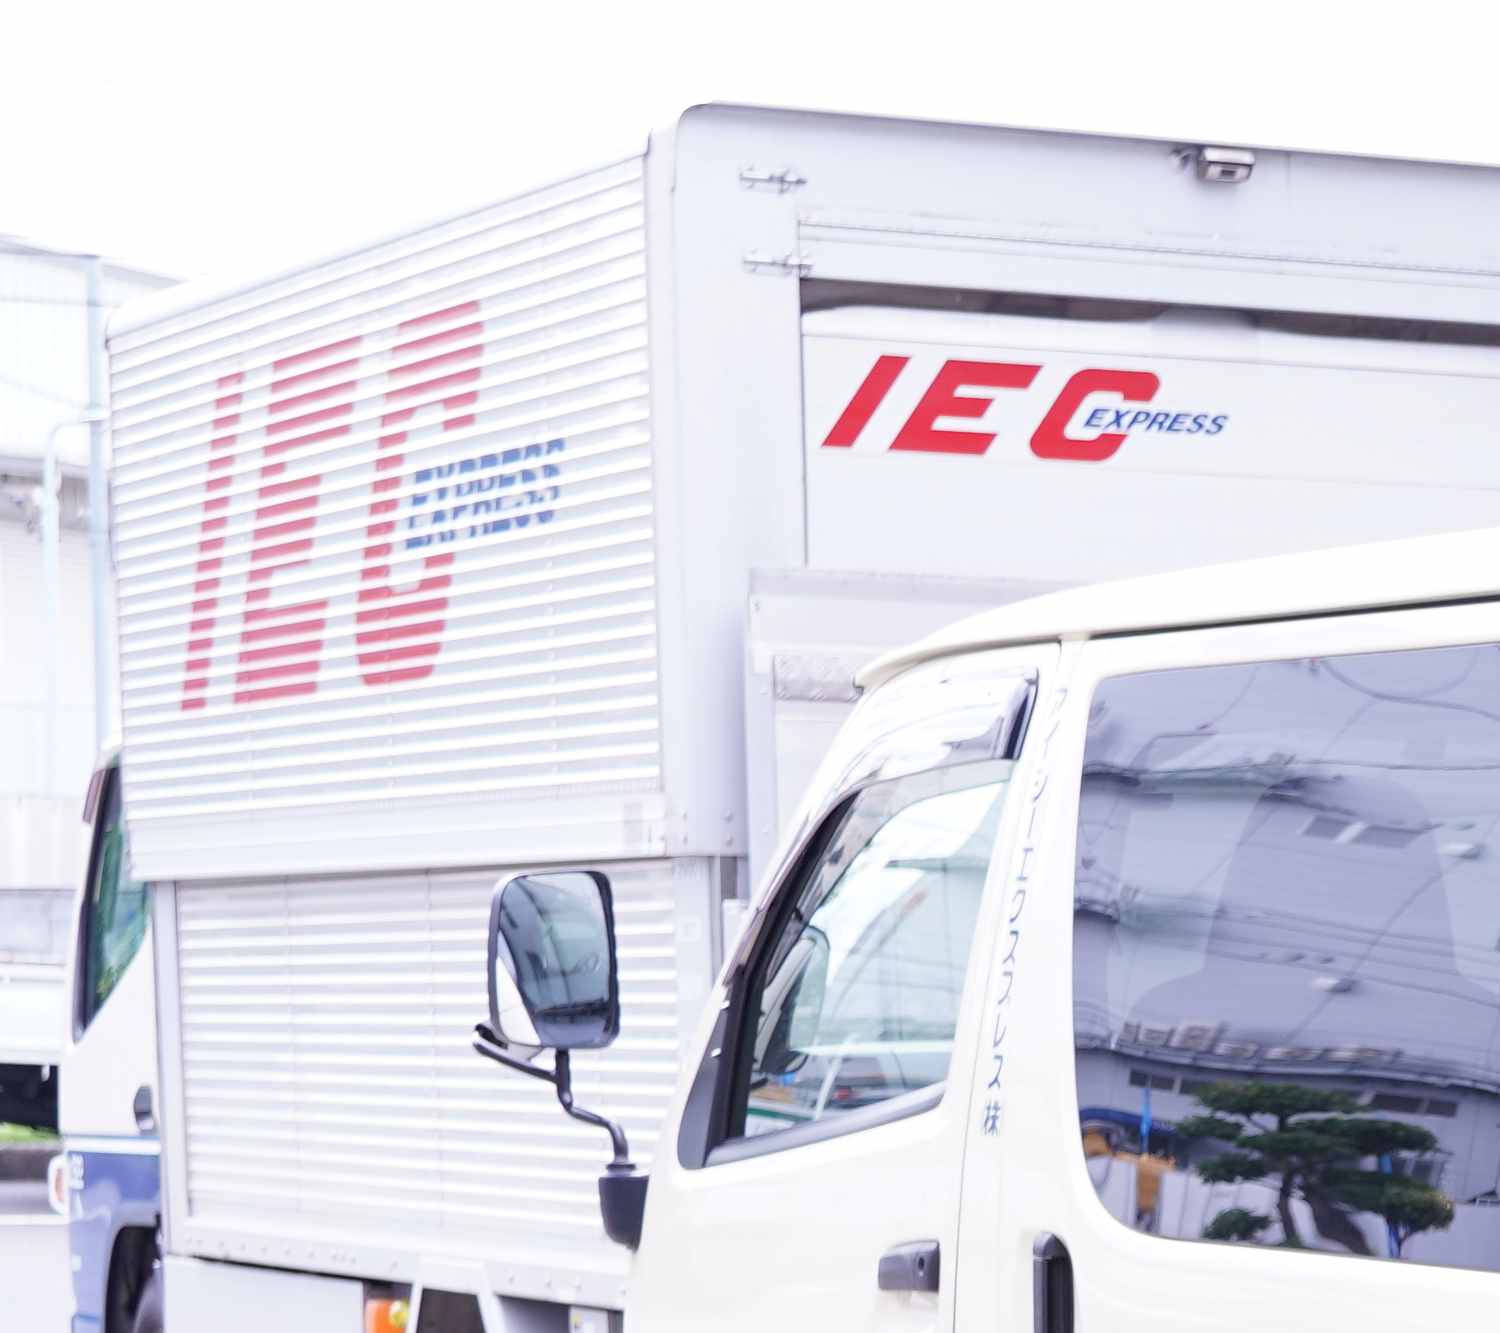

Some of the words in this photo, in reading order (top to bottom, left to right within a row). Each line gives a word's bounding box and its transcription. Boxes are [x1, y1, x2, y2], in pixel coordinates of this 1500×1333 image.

[181, 300, 484, 711] IEC
[406, 437, 566, 550] EXPRESS
[821, 354, 1161, 462] IEC
[1083, 407, 1230, 436] EXPRESS
